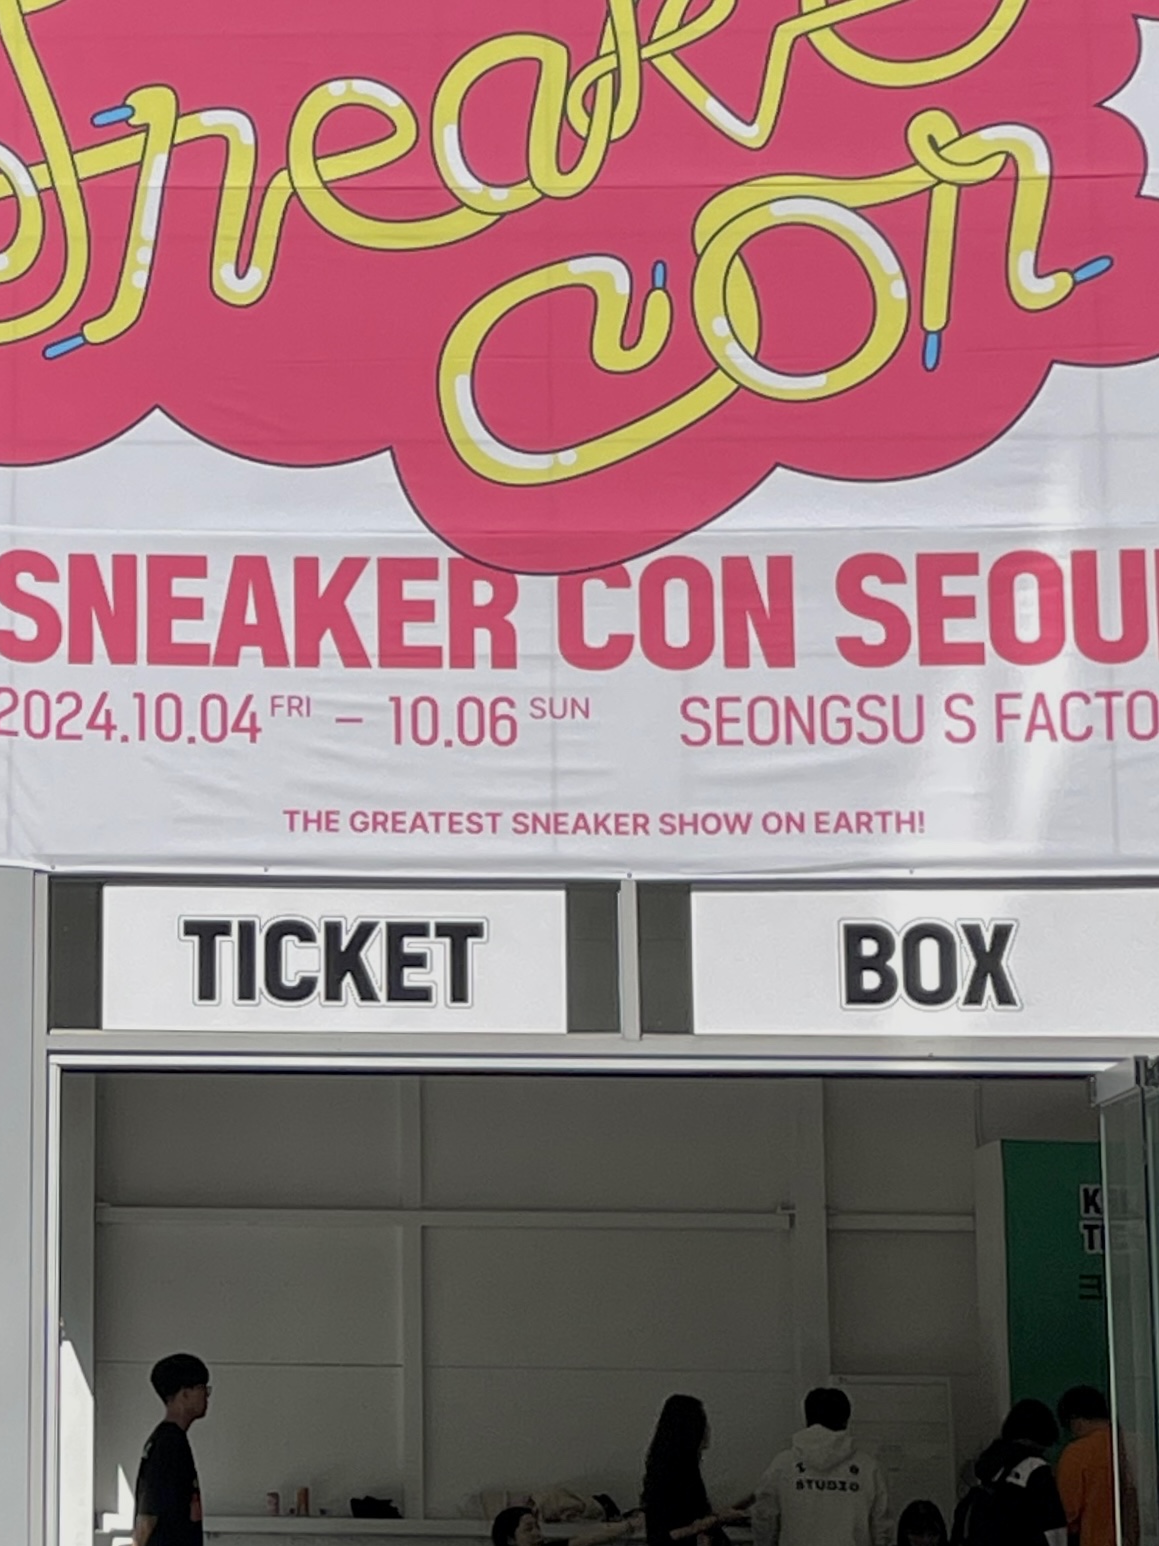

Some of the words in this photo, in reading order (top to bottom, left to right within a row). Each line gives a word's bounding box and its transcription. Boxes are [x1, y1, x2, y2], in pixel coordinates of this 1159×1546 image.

[557, 554, 797, 672] CON
[834, 547, 1159, 669] SEOU
[270, 694, 312, 720] FRI
[389, 694, 519, 748] 10.06
[529, 698, 592, 720] SUN
[679, 692, 926, 748] SEONGSU
[943, 691, 978, 745] S
[283, 808, 339, 833] THE
[348, 809, 501, 835] GREATEST
[511, 810, 651, 837] SNEAKER
[658, 810, 754, 837] SHOW
[762, 811, 807, 836] ON
[814, 809, 926, 835] EARTH!
[180, 917, 487, 1005] TICKET
[841, 921, 1020, 1008] BOX
[795, 1479, 861, 1493] STUDIO
